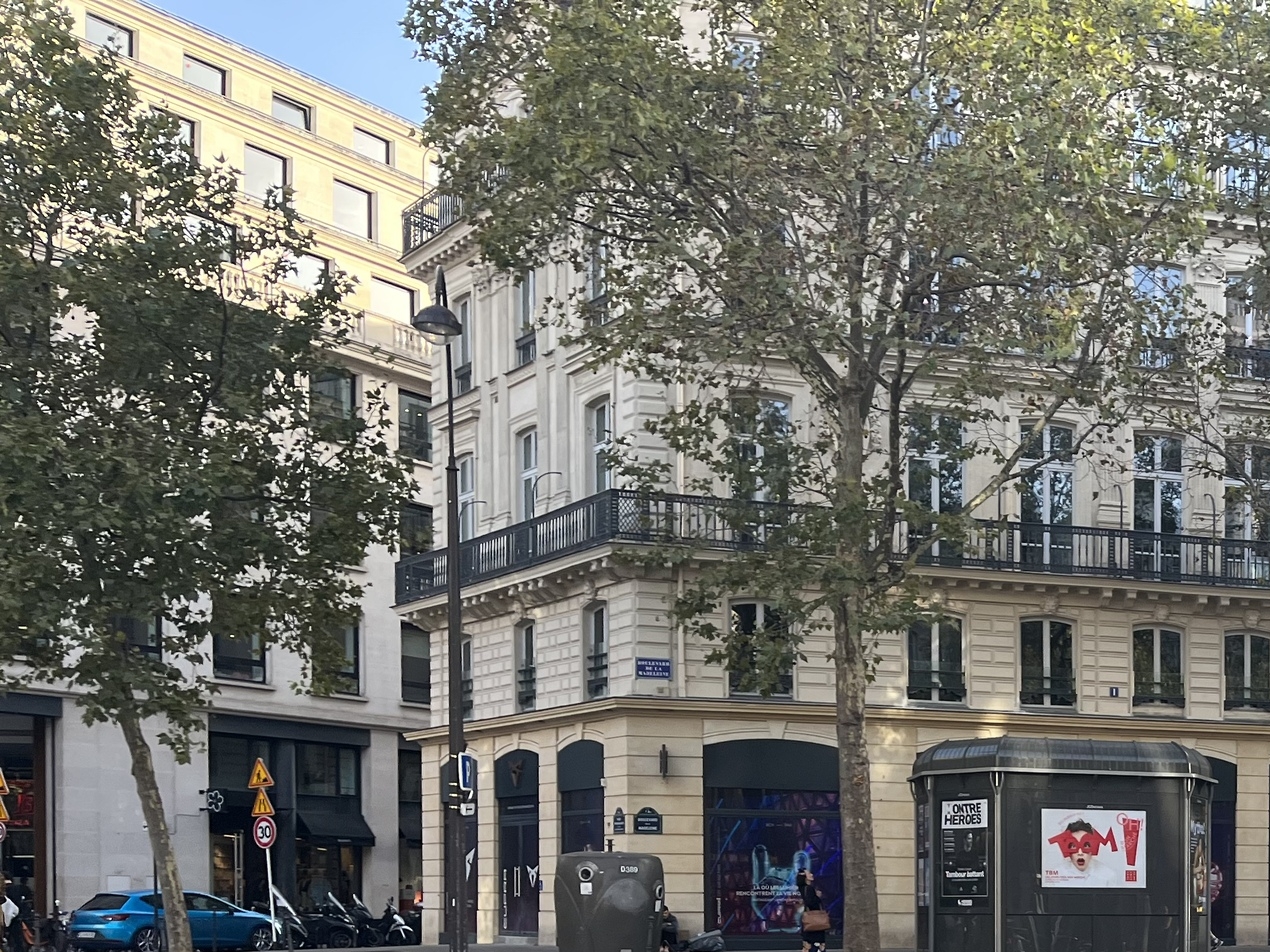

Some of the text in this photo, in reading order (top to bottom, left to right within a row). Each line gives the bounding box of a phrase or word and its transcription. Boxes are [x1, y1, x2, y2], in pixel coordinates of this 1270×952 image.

[944, 813, 982, 826] HEROES
[258, 825, 272, 839] 30
[620, 865, 639, 873] D389
